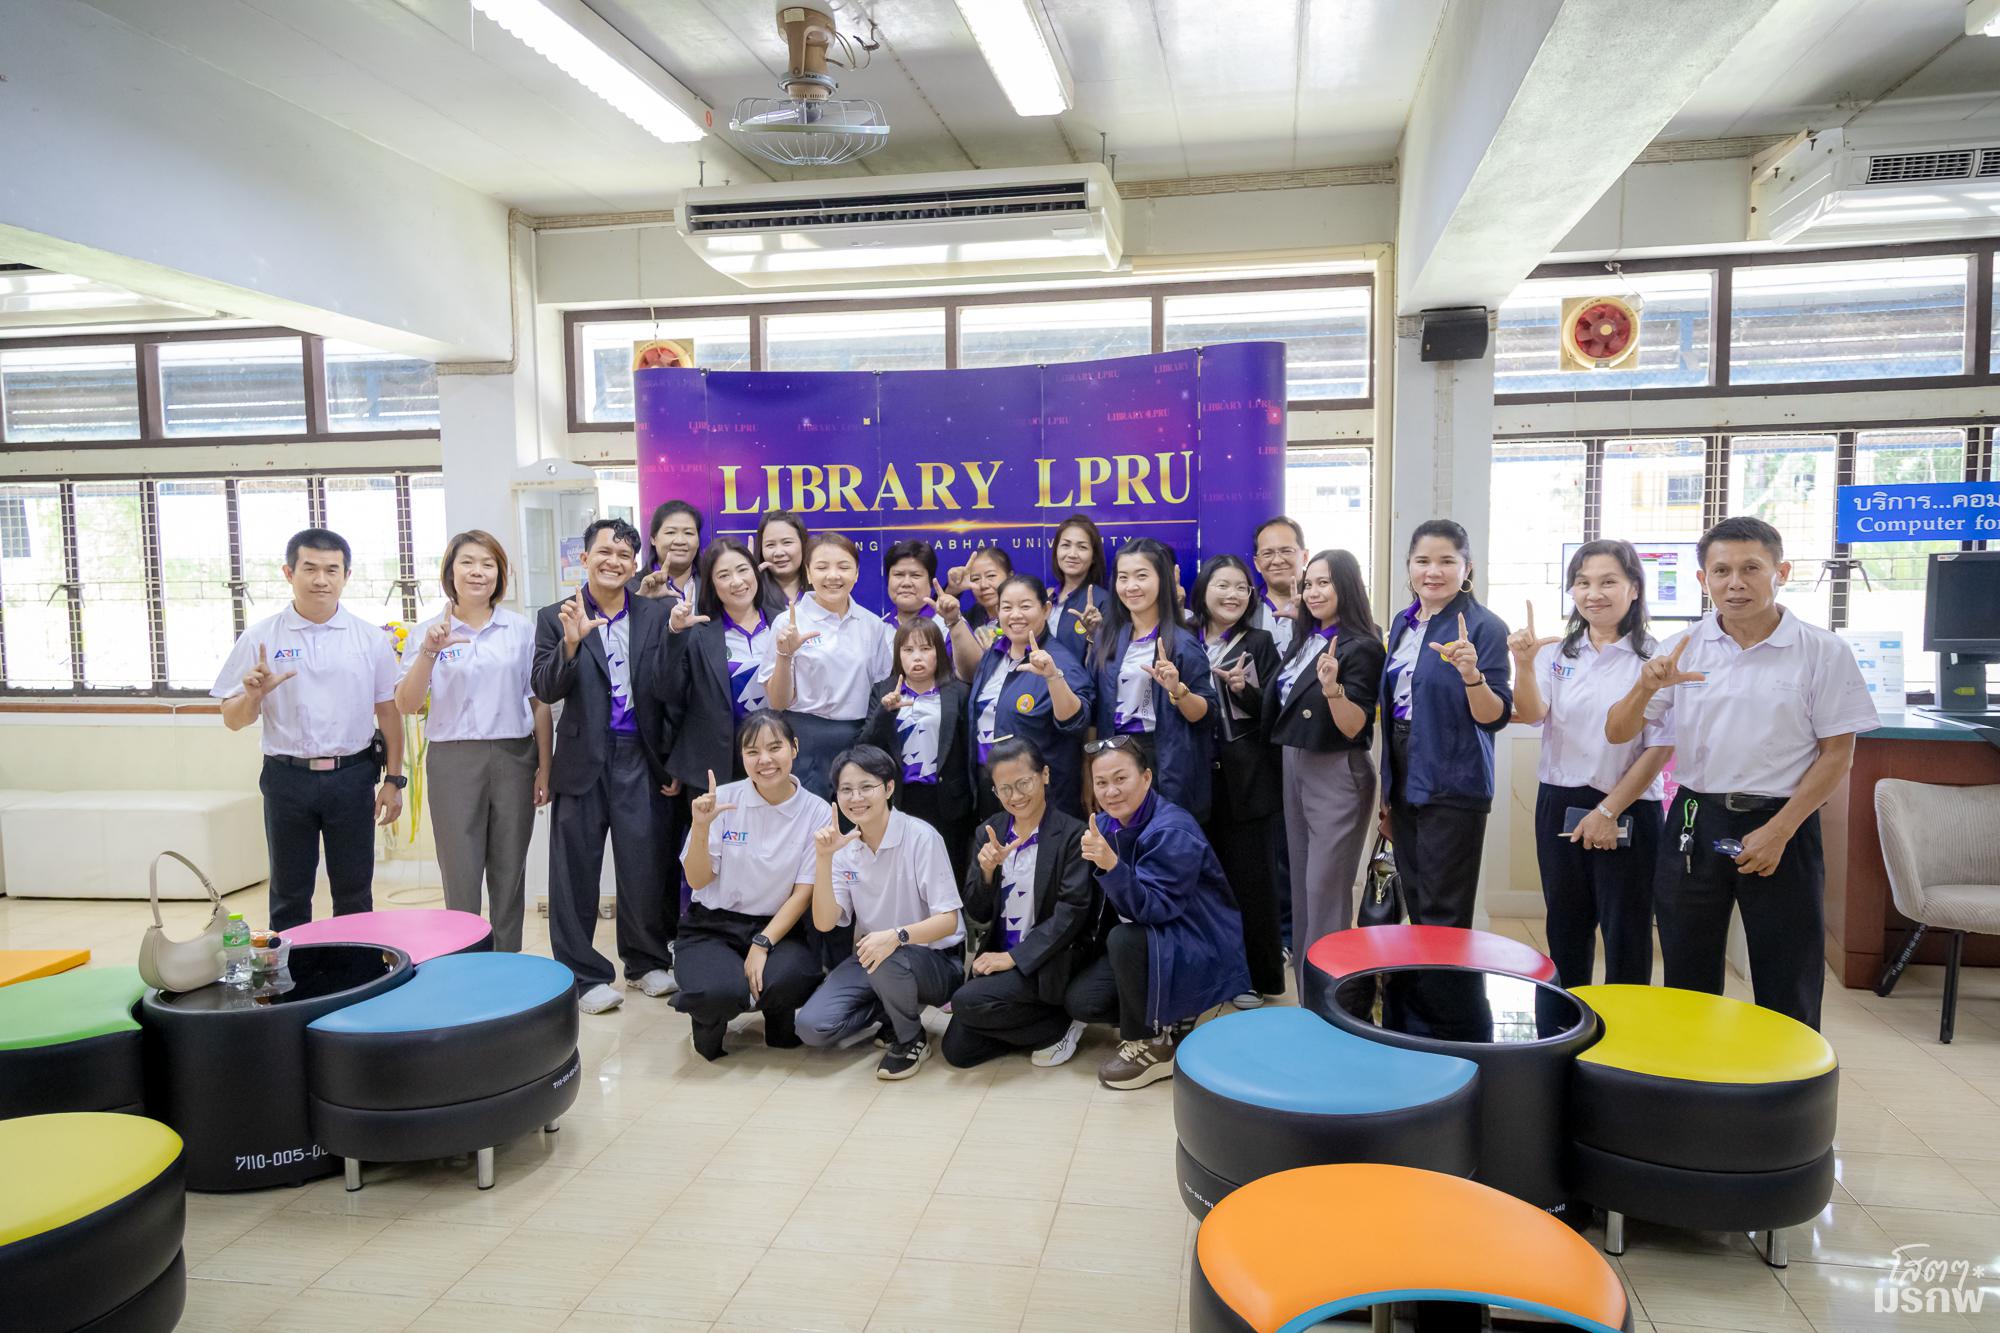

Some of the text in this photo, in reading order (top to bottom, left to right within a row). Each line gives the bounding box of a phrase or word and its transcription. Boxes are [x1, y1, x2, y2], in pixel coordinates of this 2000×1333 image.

[1203, 401, 1242, 412] LIBRARY
[1107, 410, 1144, 421] LIBRARY
[734, 424, 759, 432] LPRU
[719, 449, 1194, 514] LIBRARY LPRU
[1856, 516, 1966, 535] Computer
[274, 648, 302, 659] ARIT
[722, 830, 749, 841] ARIT
